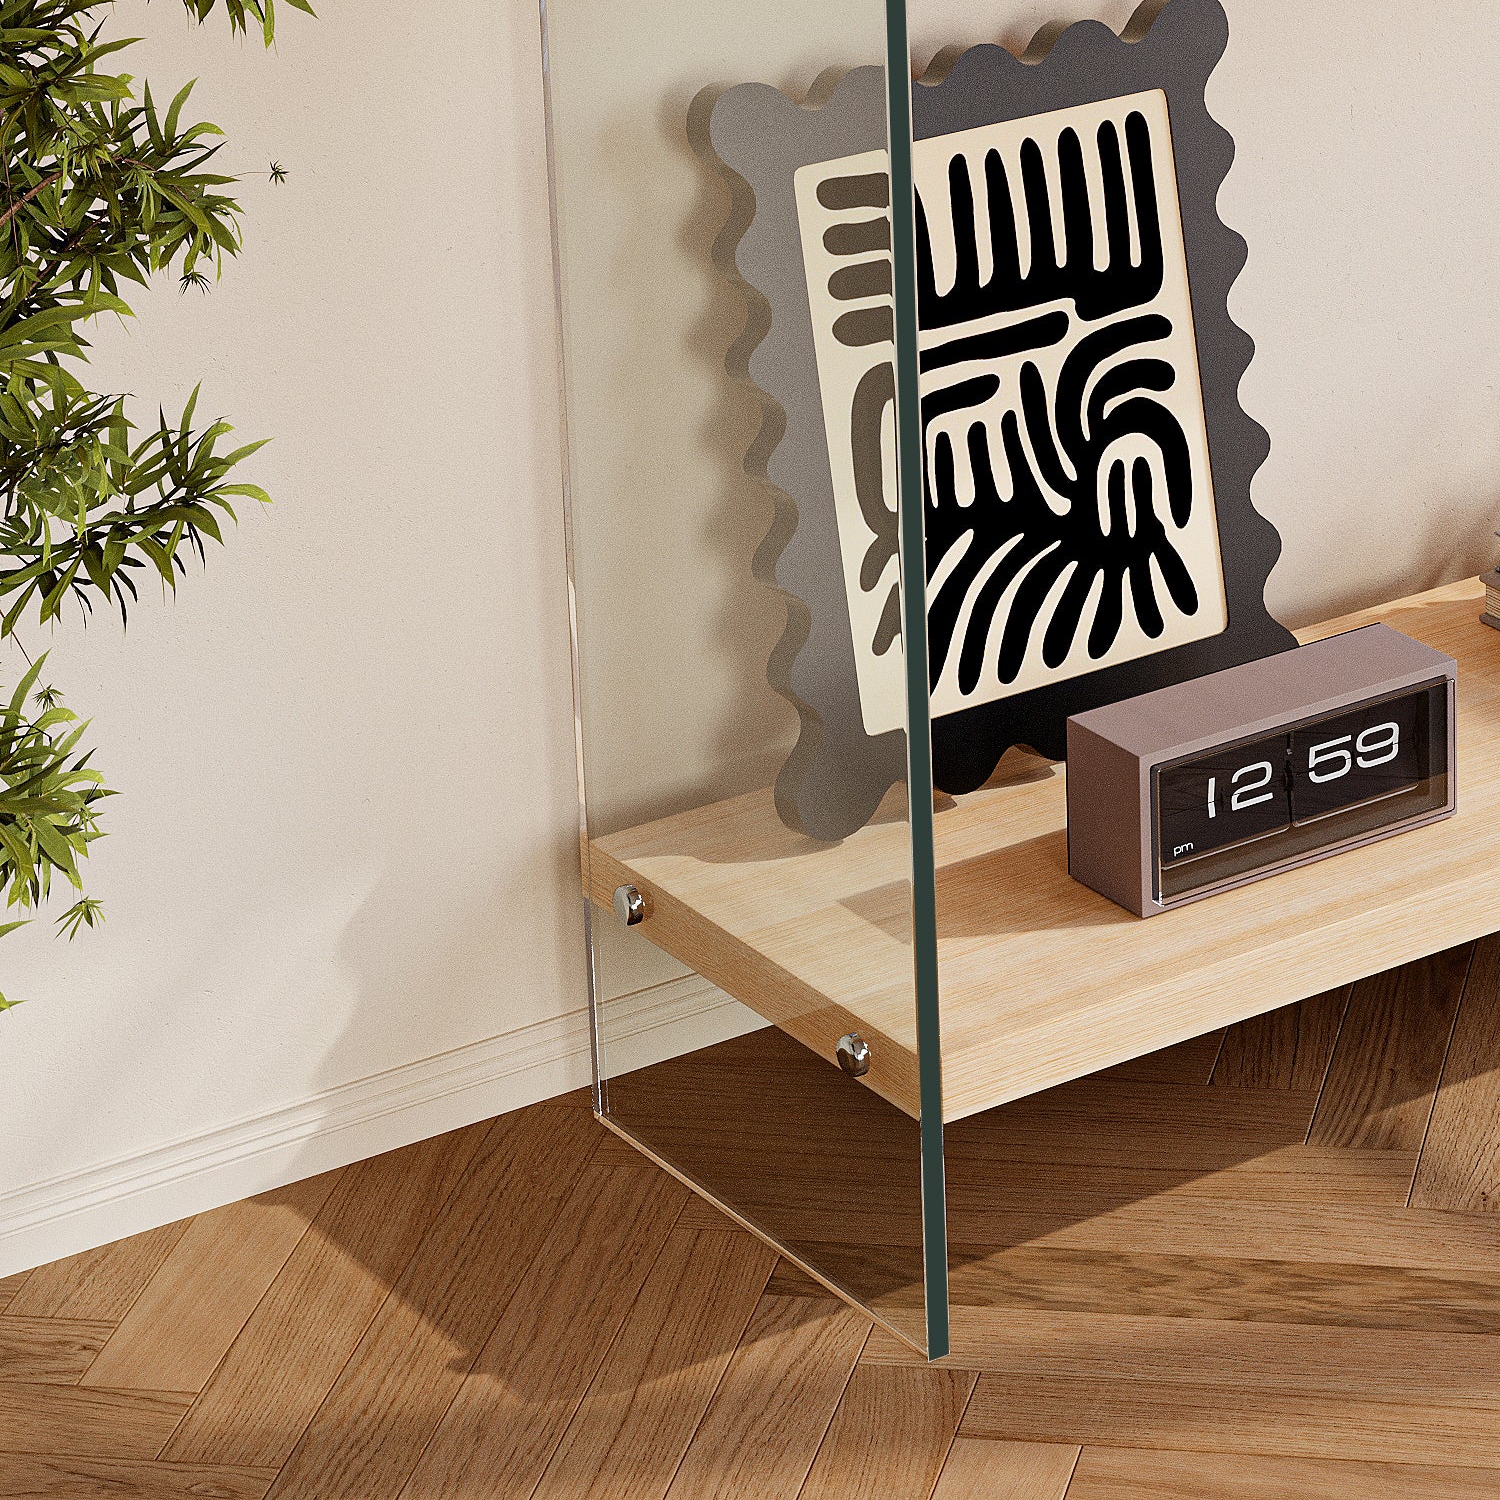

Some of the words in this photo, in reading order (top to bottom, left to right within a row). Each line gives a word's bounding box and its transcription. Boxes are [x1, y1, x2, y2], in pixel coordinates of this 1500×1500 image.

[1207, 761, 1273, 818] 12
[1308, 721, 1399, 783] 59
[1173, 841, 1194, 857] pm
